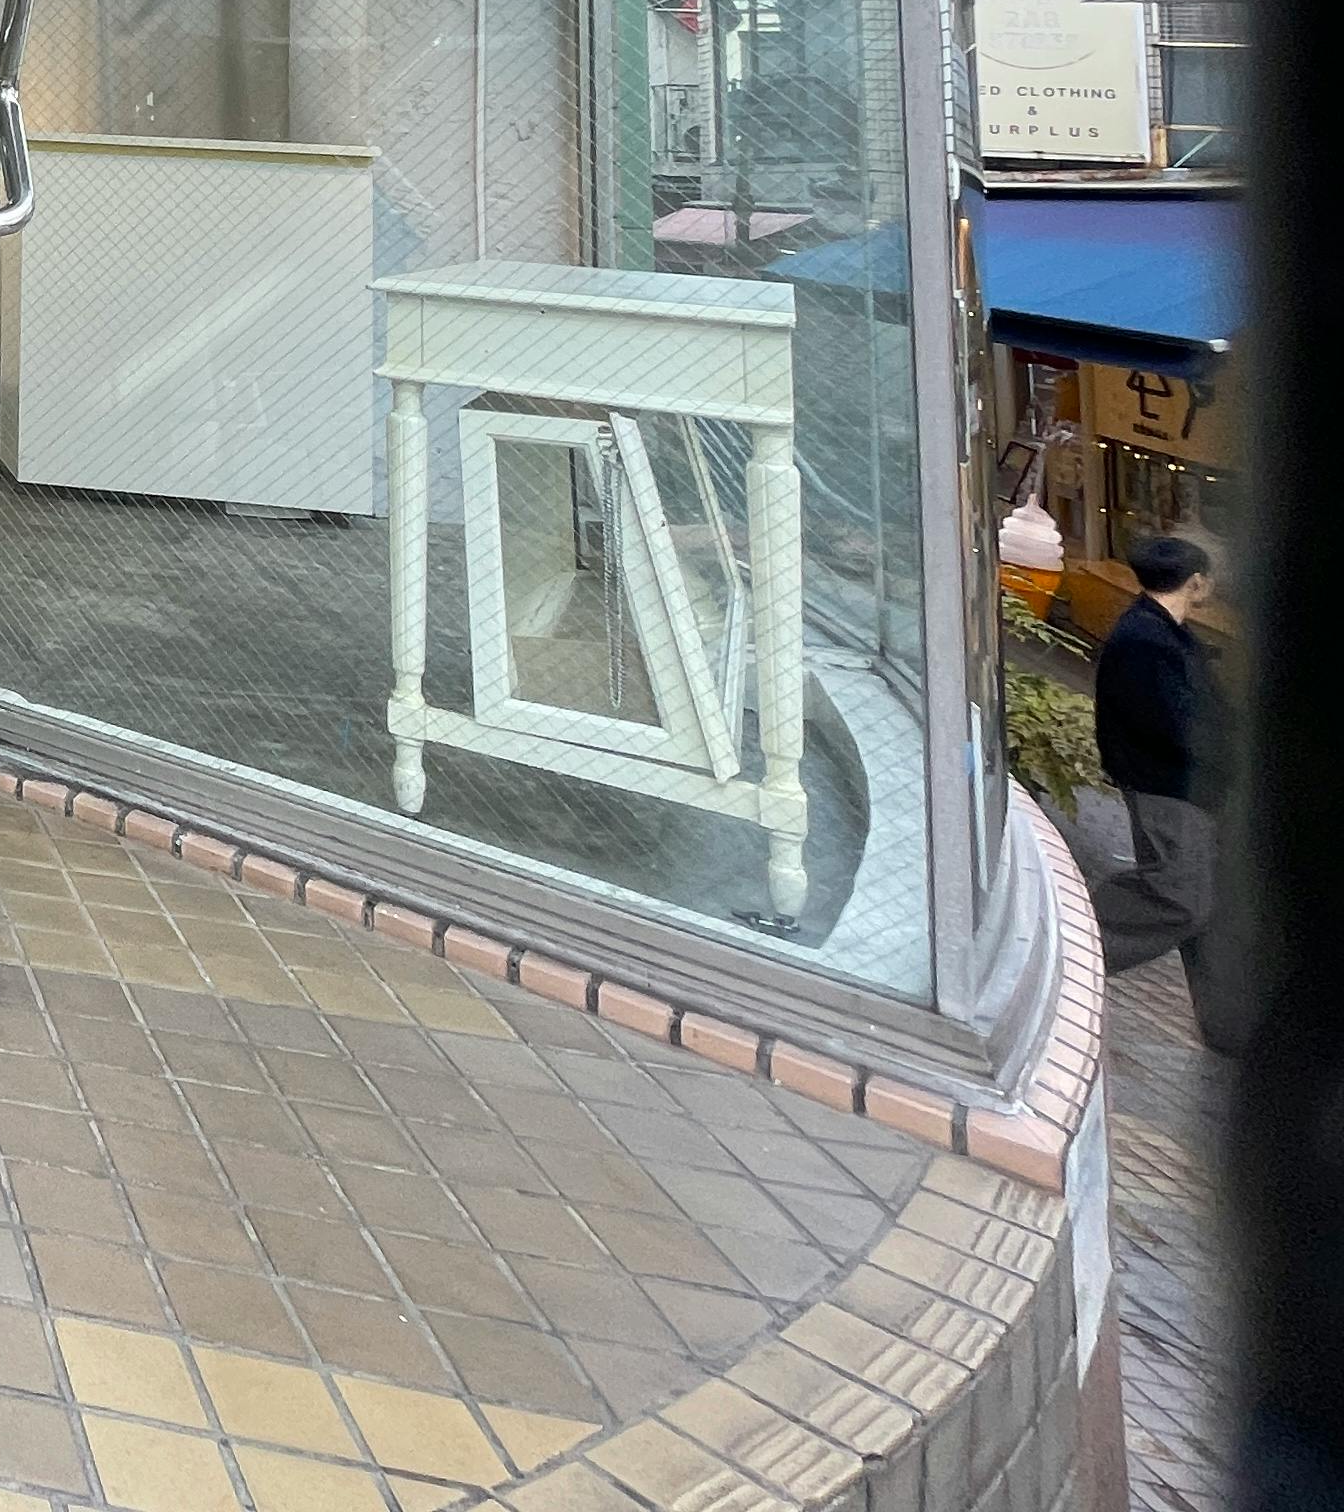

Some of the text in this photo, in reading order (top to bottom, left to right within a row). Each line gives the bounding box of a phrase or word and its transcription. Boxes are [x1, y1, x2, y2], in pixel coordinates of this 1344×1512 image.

[979, 85, 1117, 100] ED CLOTHING
[1027, 105, 1038, 116] &
[989, 124, 1100, 138] URPLUS
